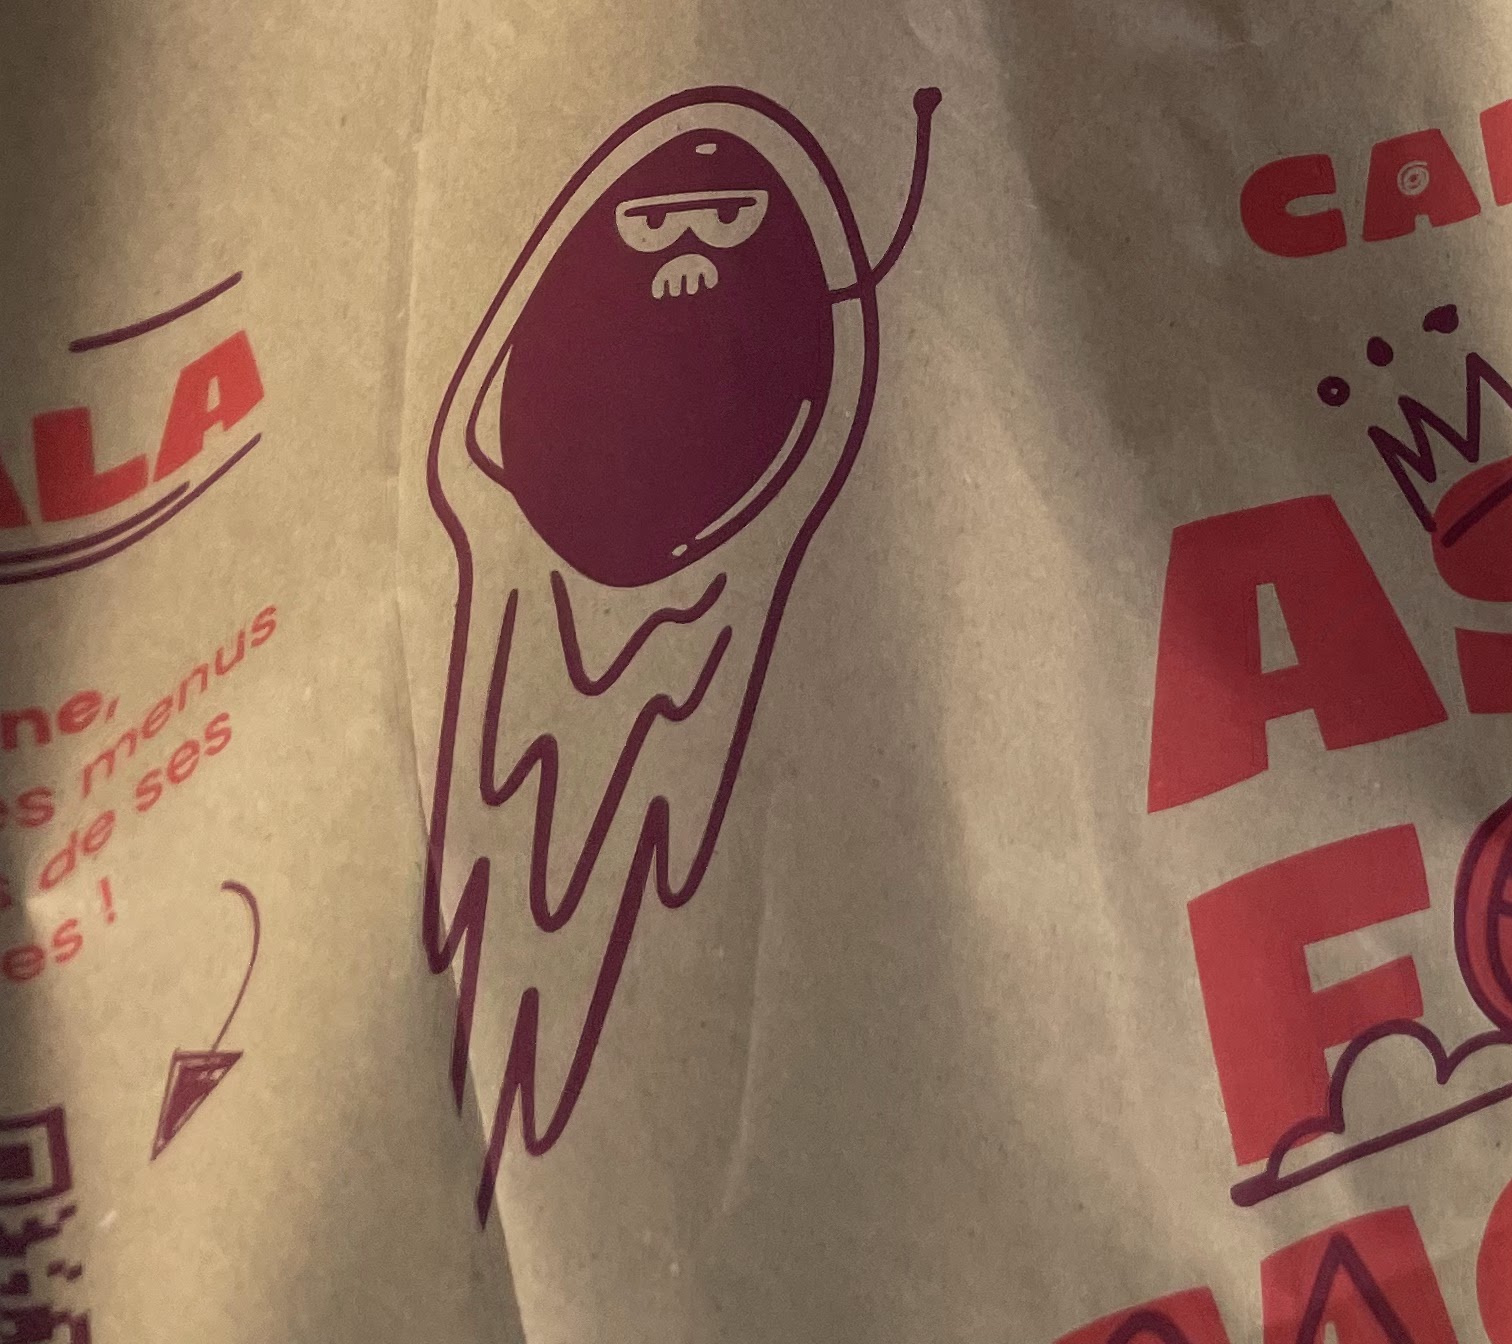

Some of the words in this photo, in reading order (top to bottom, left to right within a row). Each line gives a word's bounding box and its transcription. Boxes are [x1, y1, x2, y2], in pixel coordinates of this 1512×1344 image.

[0, 329, 265, 530] LA
[82, 605, 278, 798] menus
[38, 810, 118, 892] de
[135, 712, 232, 813] ses
